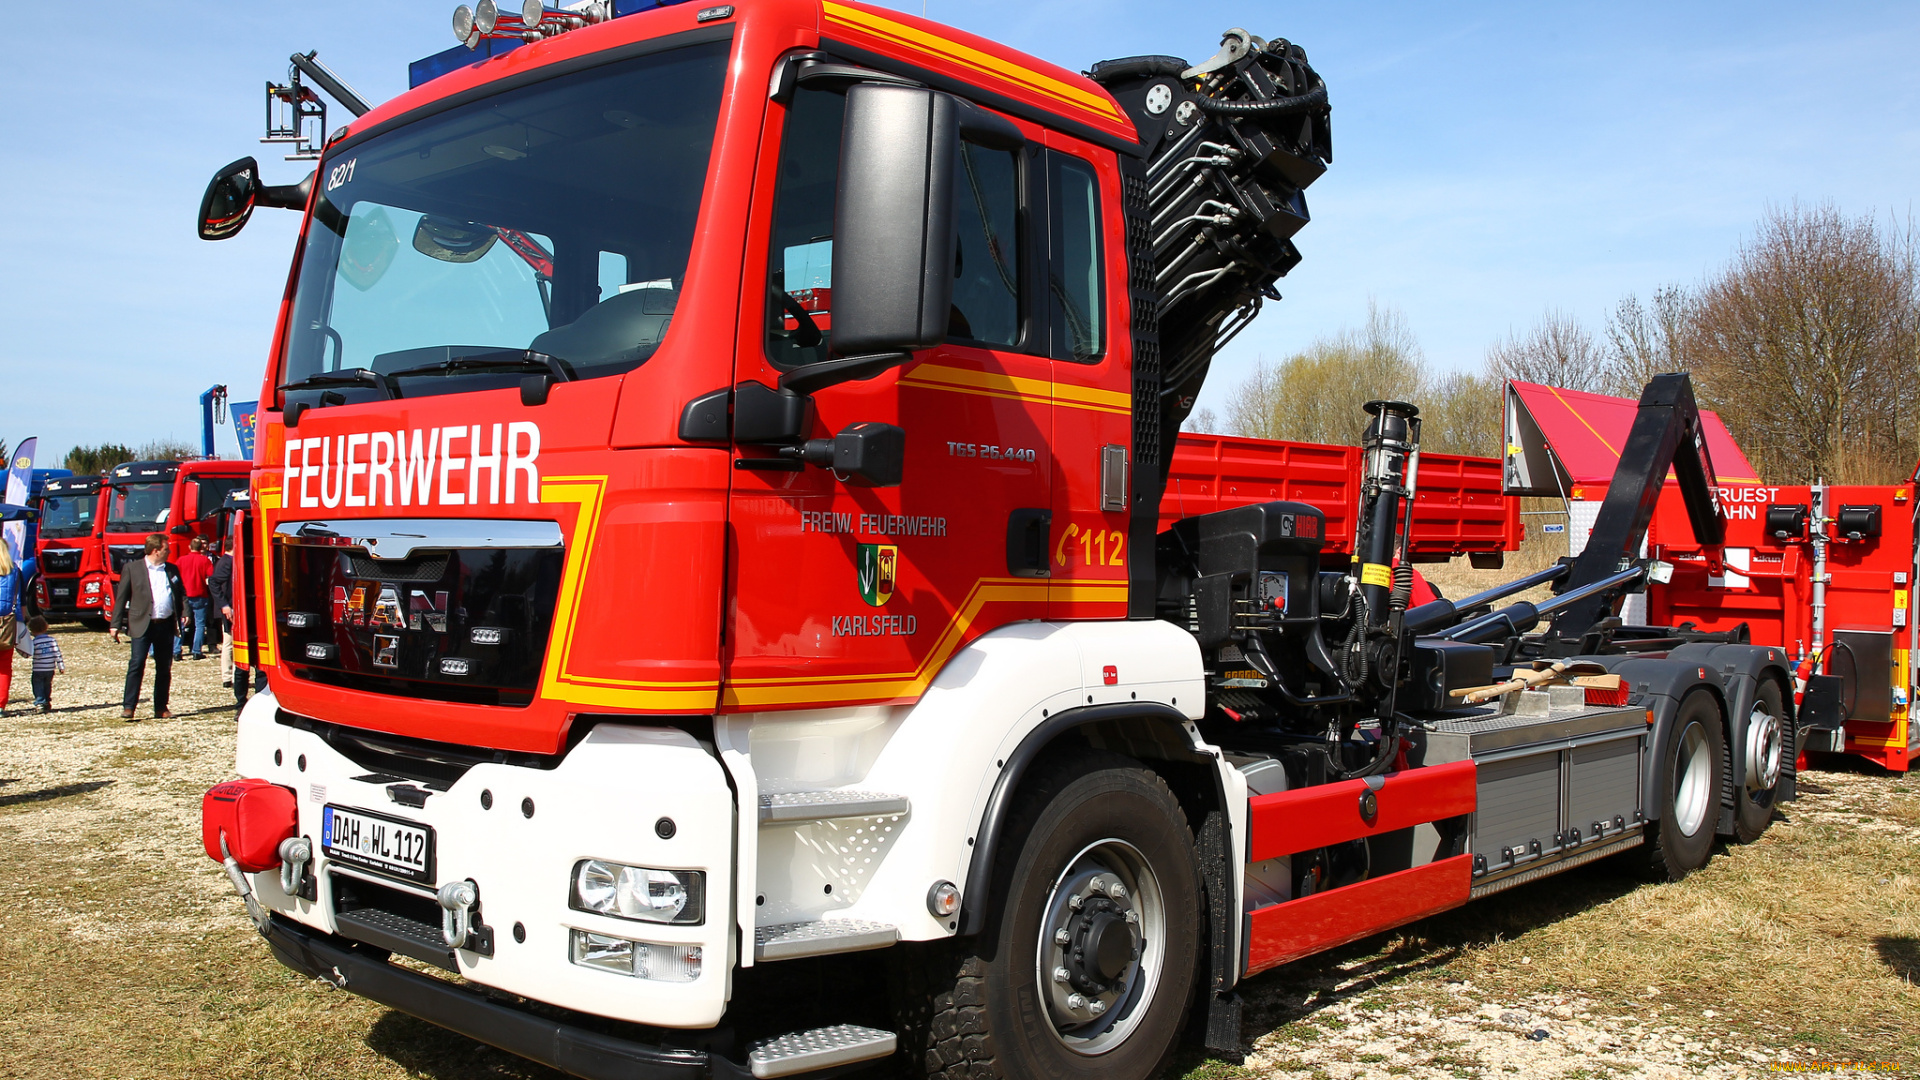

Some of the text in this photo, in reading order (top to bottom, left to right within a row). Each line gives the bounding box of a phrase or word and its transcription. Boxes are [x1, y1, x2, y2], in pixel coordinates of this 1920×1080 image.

[328, 157, 358, 192] 82/1
[282, 421, 541, 509] FEUERWEHR
[947, 441, 1036, 462] TGS 26.440
[1718, 488, 1780, 503] RUEST
[801, 511, 948, 537] FREIW. FEUERWEHR
[1295, 514, 1318, 539] HIAB
[1080, 530, 1124, 567] 112
[333, 585, 450, 633] MAN
[831, 615, 917, 638] KARLSFELD
[332, 814, 361, 850] DAH
[372, 824, 390, 858] WL
[394, 829, 425, 866] 112
